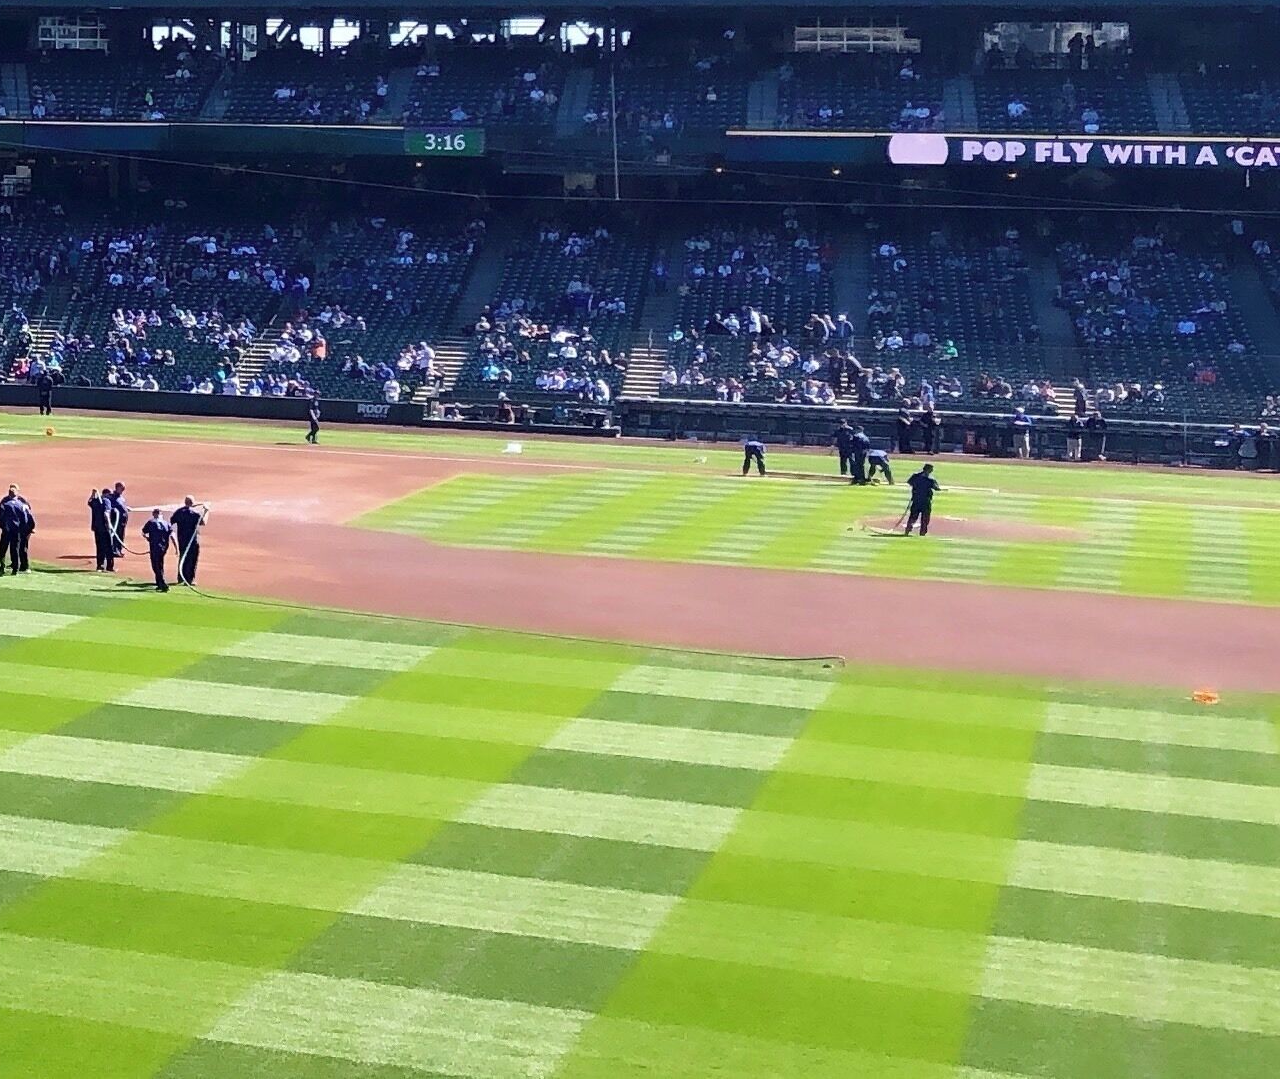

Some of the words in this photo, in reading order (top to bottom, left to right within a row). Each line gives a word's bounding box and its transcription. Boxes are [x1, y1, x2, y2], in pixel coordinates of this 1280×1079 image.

[423, 134, 466, 152] 3:16
[962, 140, 1026, 162] POP
[1035, 142, 1093, 163] FLY
[1102, 144, 1186, 165] WITH
[1195, 145, 1218, 166] A
[357, 403, 390, 414] ROOT
